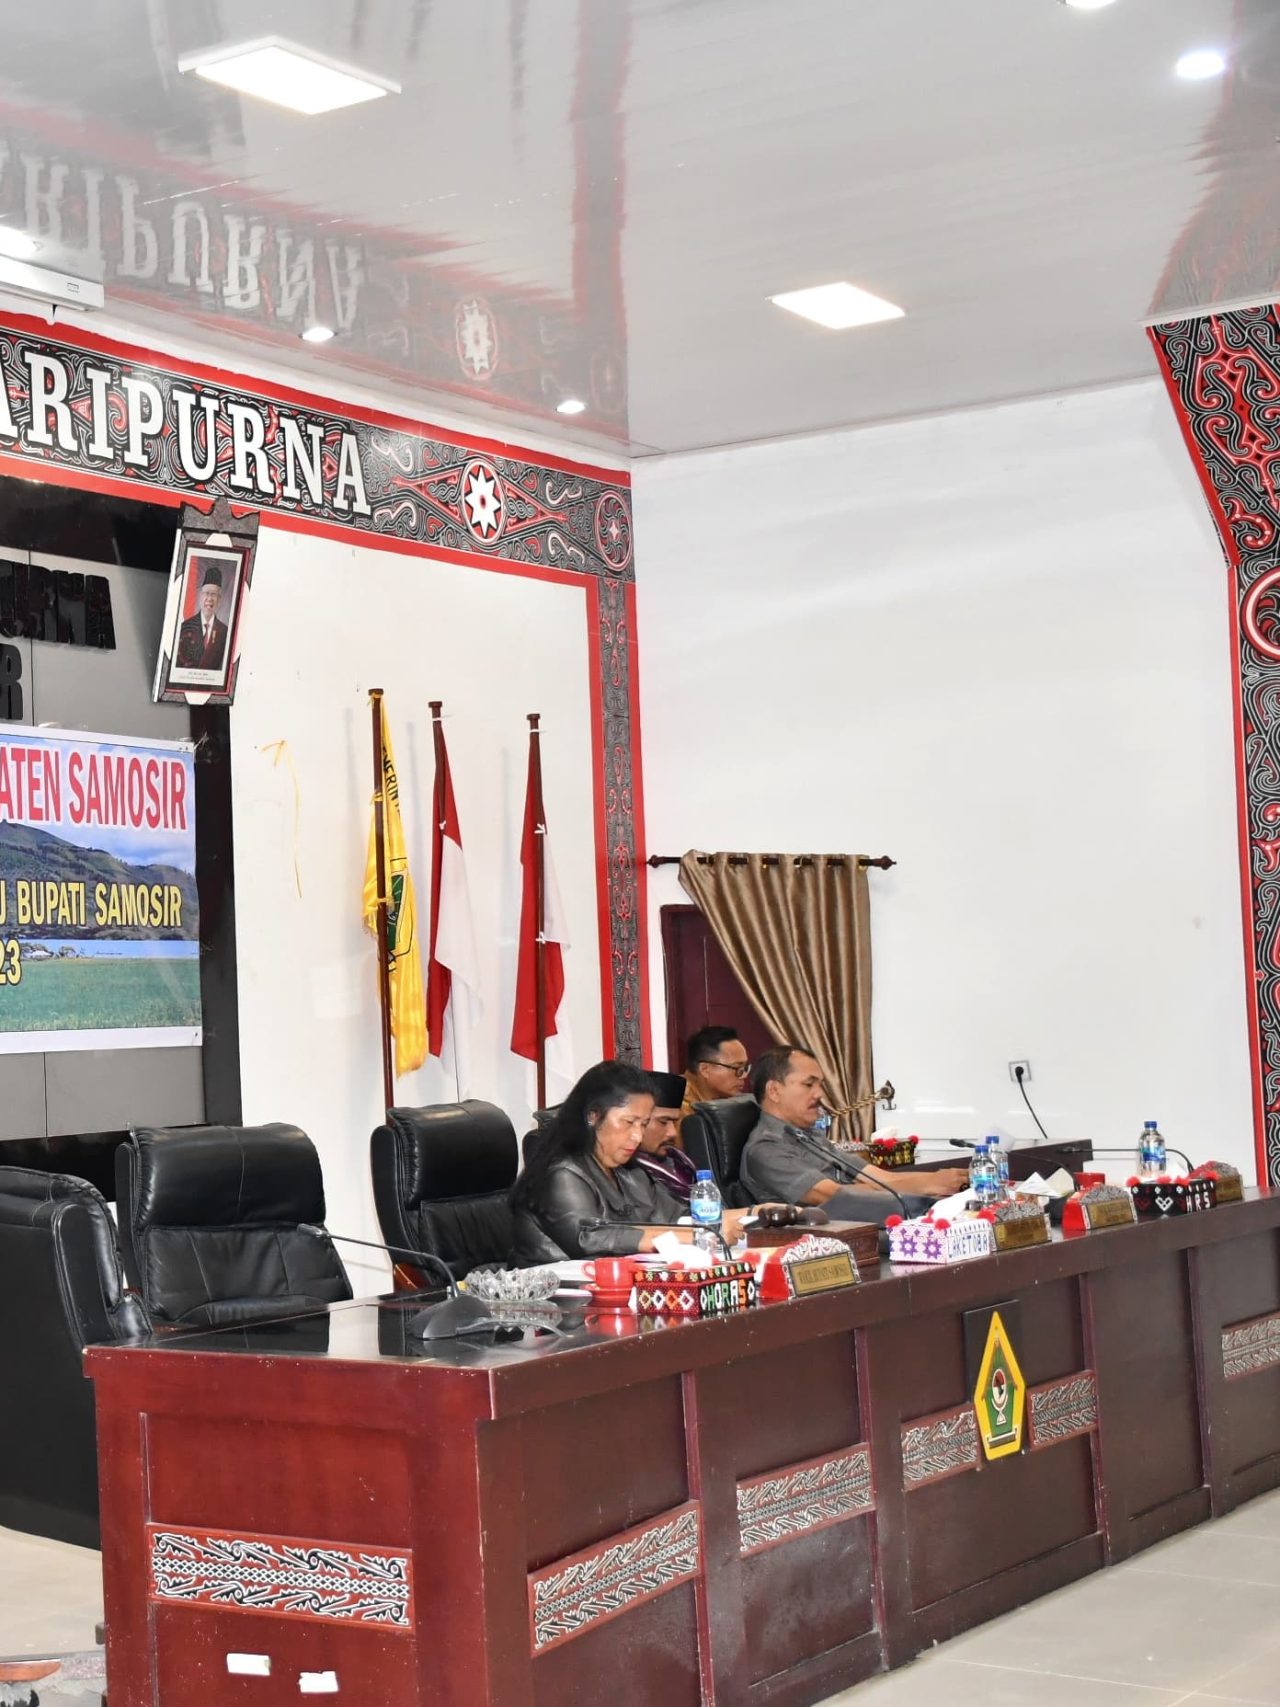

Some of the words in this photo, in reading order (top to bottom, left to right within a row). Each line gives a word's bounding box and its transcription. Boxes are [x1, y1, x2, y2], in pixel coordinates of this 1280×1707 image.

[68, 752, 188, 831] SAMOSIR
[17, 880, 87, 927] BUPATI
[94, 882, 184, 929] SAMOSIR
[706, 1279, 747, 1311] HORAS
